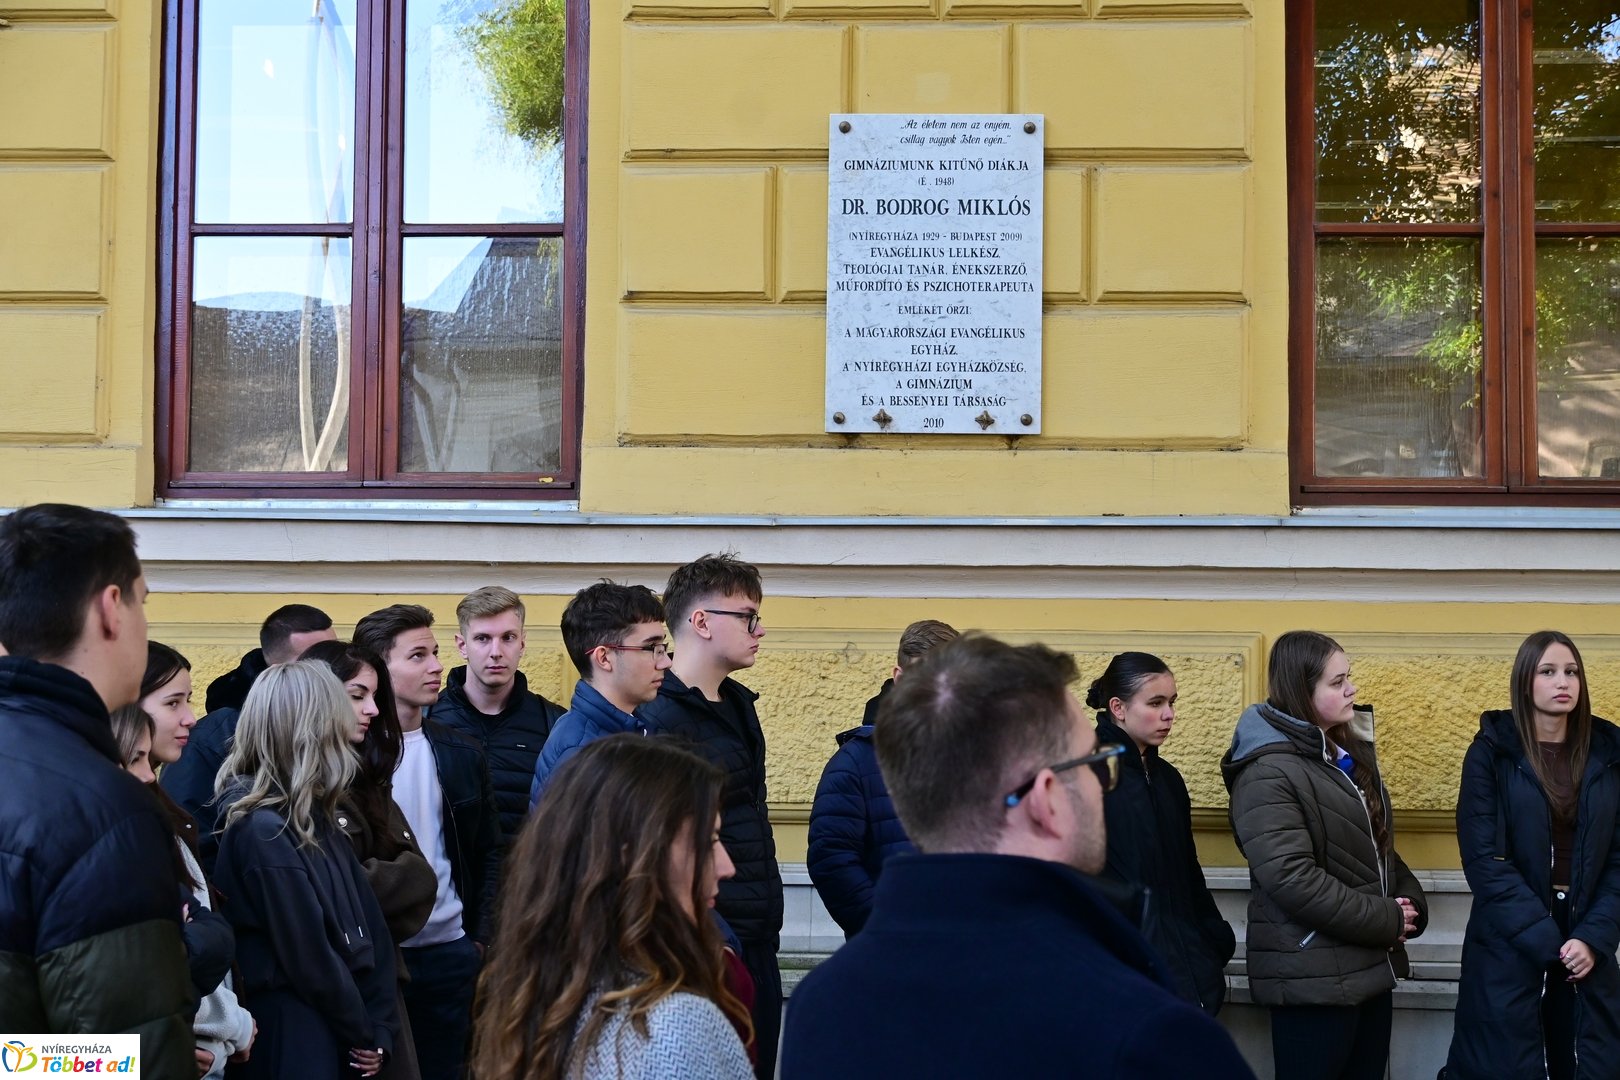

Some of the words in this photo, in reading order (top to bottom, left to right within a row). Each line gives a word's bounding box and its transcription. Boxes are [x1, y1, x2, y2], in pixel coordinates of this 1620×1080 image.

[921, 119, 947, 130] életem
[950, 121, 967, 130] nem
[970, 121, 981, 130] az
[900, 134, 925, 146] csillag
[928, 135, 957, 147] vagyok
[960, 134, 981, 145] Isten
[844, 158, 934, 171] GIMNÁZIUMUNK
[988, 158, 1029, 171] DIÁKJA
[935, 177, 955, 187] 1948)
[842, 198, 869, 216] DR.
[876, 198, 949, 216] BODROG
[958, 194, 1031, 217] MIKLÓS
[848, 230, 919, 242] (NYÍREGYHÁZA
[922, 232, 940, 242] 1929
[950, 232, 997, 242] BUDAPEST
[1000, 232, 1023, 242] 2009)
[870, 245, 945, 258] EVANGÉLIKUS
[843, 261, 904, 275] TEOLÓGIAI
[836, 278, 903, 292] MŰFORDÍTÓ
[907, 279, 920, 292] ÉS
[923, 281, 1035, 293] PSZICHOTERAPEUTA
[898, 304, 943, 315] EMLÉKÉT
[844, 329, 852, 338] A
[856, 325, 946, 338] MAGYARORSZÁGI
[950, 325, 1026, 339] EVANGÉLIKUS
[842, 362, 850, 372] A
[854, 359, 932, 373] NYÍREGYHÁZI
[895, 379, 903, 389] A
[907, 376, 973, 390] GIMNÁZIUM
[861, 393, 874, 406] ÉS
[878, 396, 886, 406] A
[890, 395, 949, 406] BESSENYEI
[953, 394, 1007, 407] TÁRSASÁG
[923, 417, 945, 429] 2010
